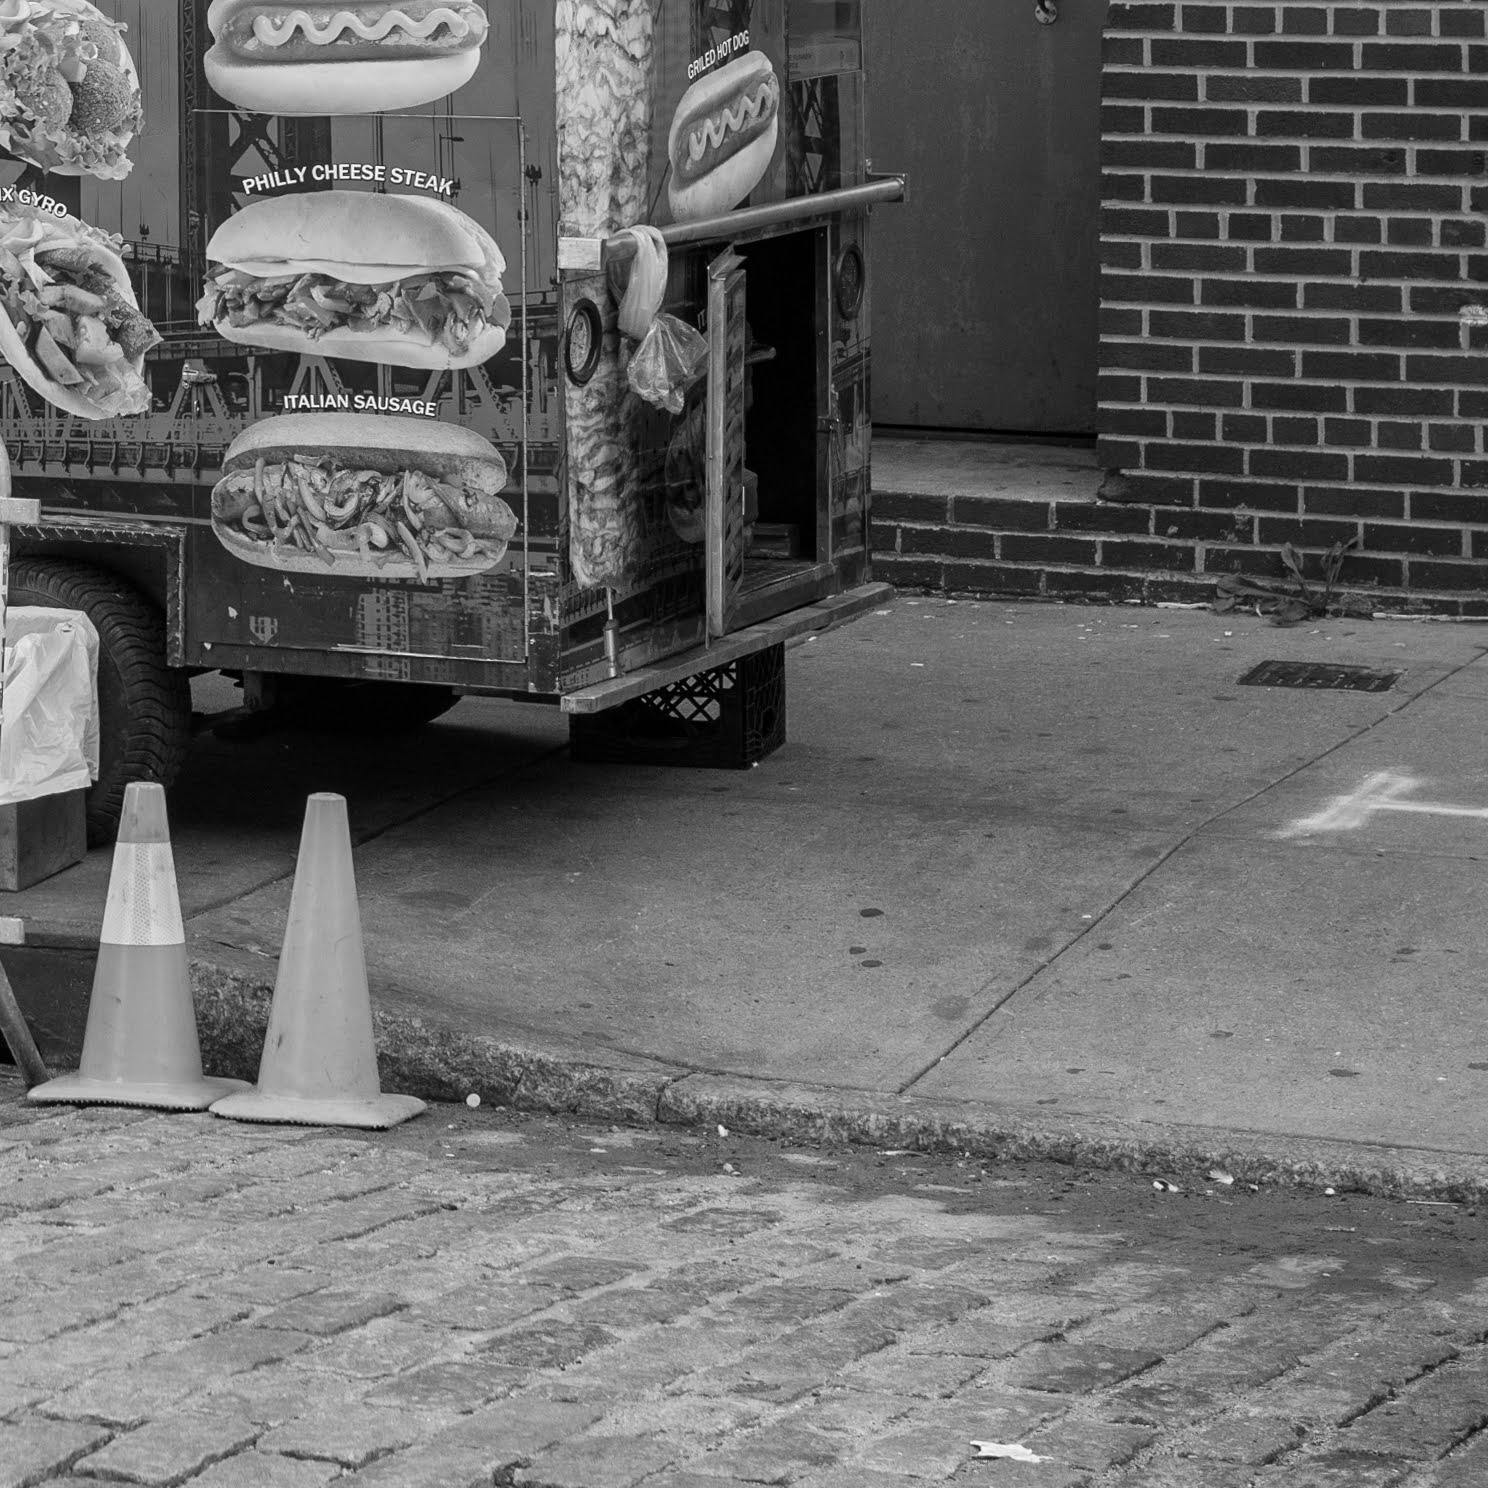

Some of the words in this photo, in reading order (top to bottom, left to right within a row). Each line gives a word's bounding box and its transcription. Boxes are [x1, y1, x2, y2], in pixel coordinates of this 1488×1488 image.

[687, 50, 716, 81] GRILED
[716, 39, 733, 61] HOT
[733, 30, 750, 51] DOG
[242, 165, 306, 195] PHILLY
[311, 163, 385, 183] CHEESE
[388, 167, 454, 195] STEAK
[16, 189, 68, 219] GYRO
[283, 394, 349, 412] ITALIAN
[352, 395, 437, 416] SAUSAGE
